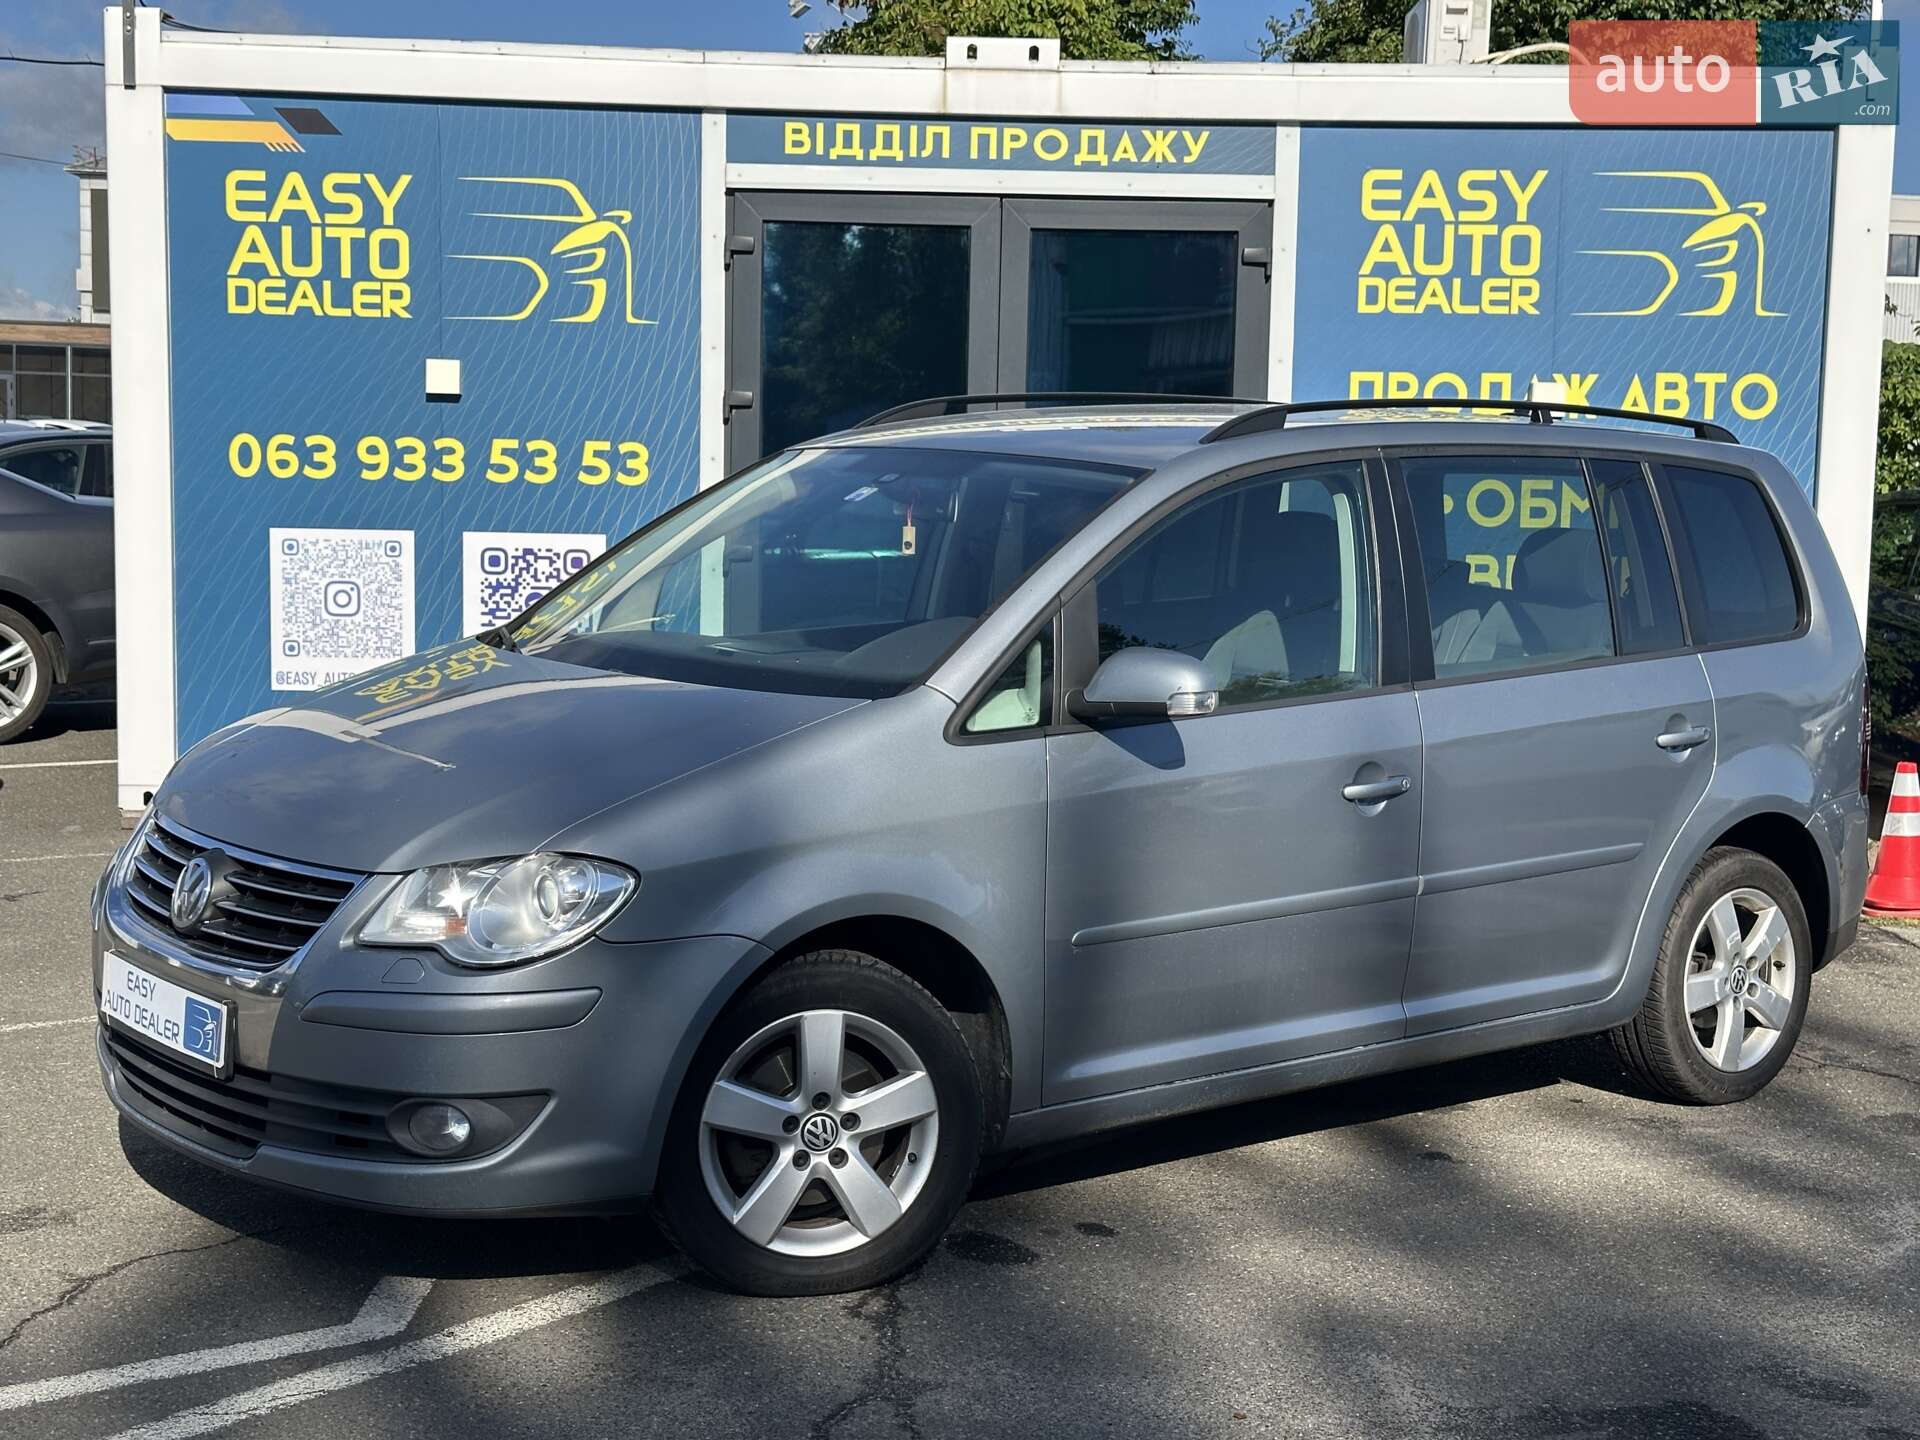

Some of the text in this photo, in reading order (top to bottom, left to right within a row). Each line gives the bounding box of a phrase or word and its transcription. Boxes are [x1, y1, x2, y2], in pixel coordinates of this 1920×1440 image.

[784, 121, 1211, 167] ВІДДІЛ ПРОДАЖУ
[225, 169, 413, 224] EASY
[1360, 168, 1549, 222] EASY
[226, 225, 411, 278] AUTO
[1358, 223, 1542, 276] AUTO
[226, 279, 413, 318] DEALER
[1357, 277, 1541, 315] DEALER
[1349, 371, 1779, 421] ПРОДЖ АВТО
[228, 432, 651, 486] 063 933 53 53
[126, 971, 157, 1001] EASY
[104, 989, 180, 1045] AUTO DEALER
